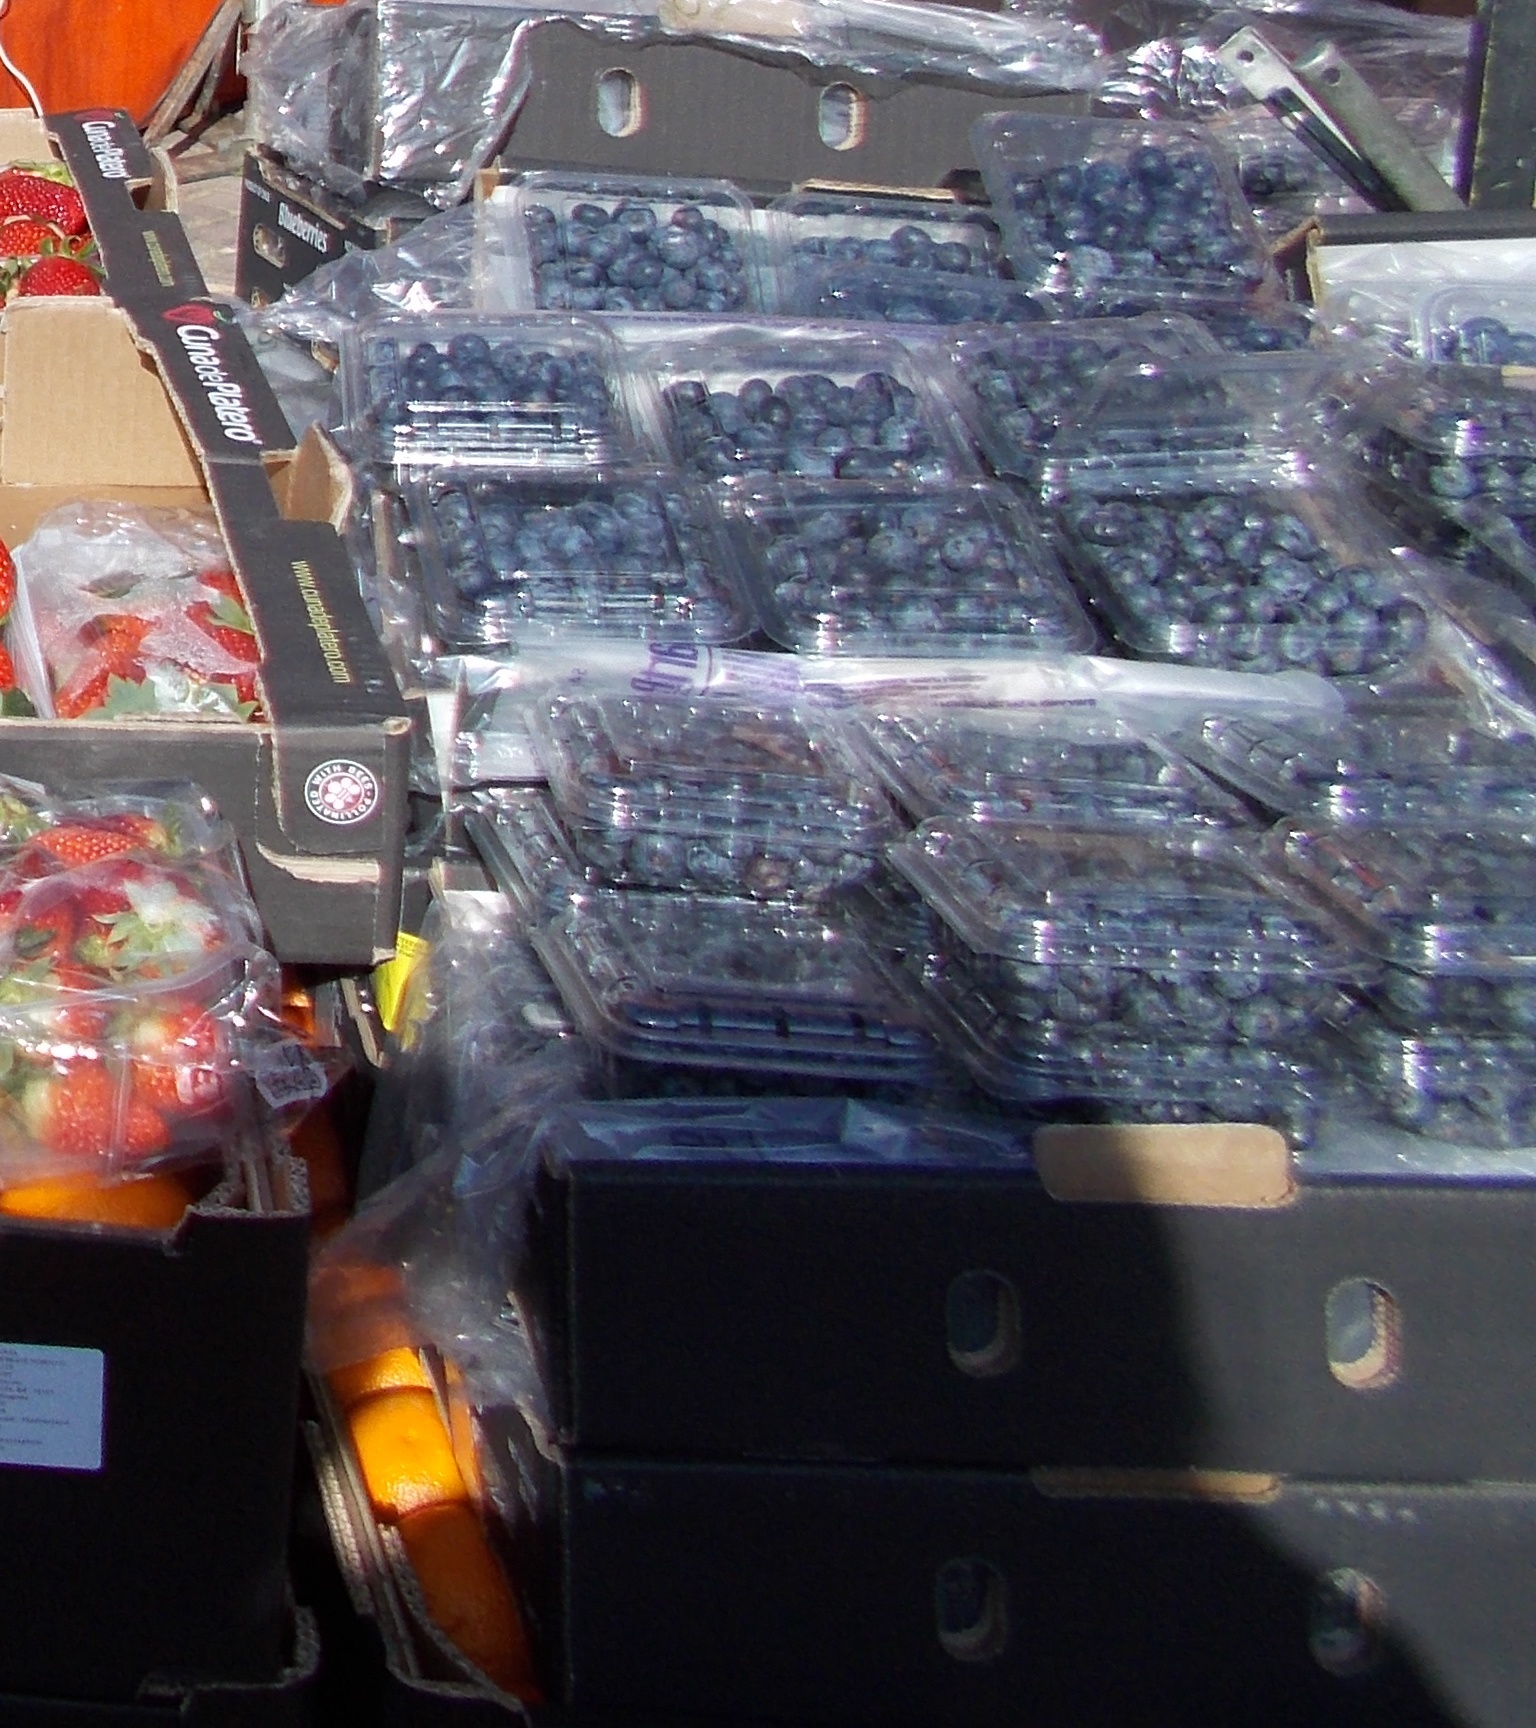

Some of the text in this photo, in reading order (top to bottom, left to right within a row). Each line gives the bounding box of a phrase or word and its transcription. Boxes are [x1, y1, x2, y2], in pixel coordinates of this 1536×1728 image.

[278, 201, 330, 254] Blueberries
[311, 763, 343, 785] WITH
[347, 765, 374, 790] BEES
